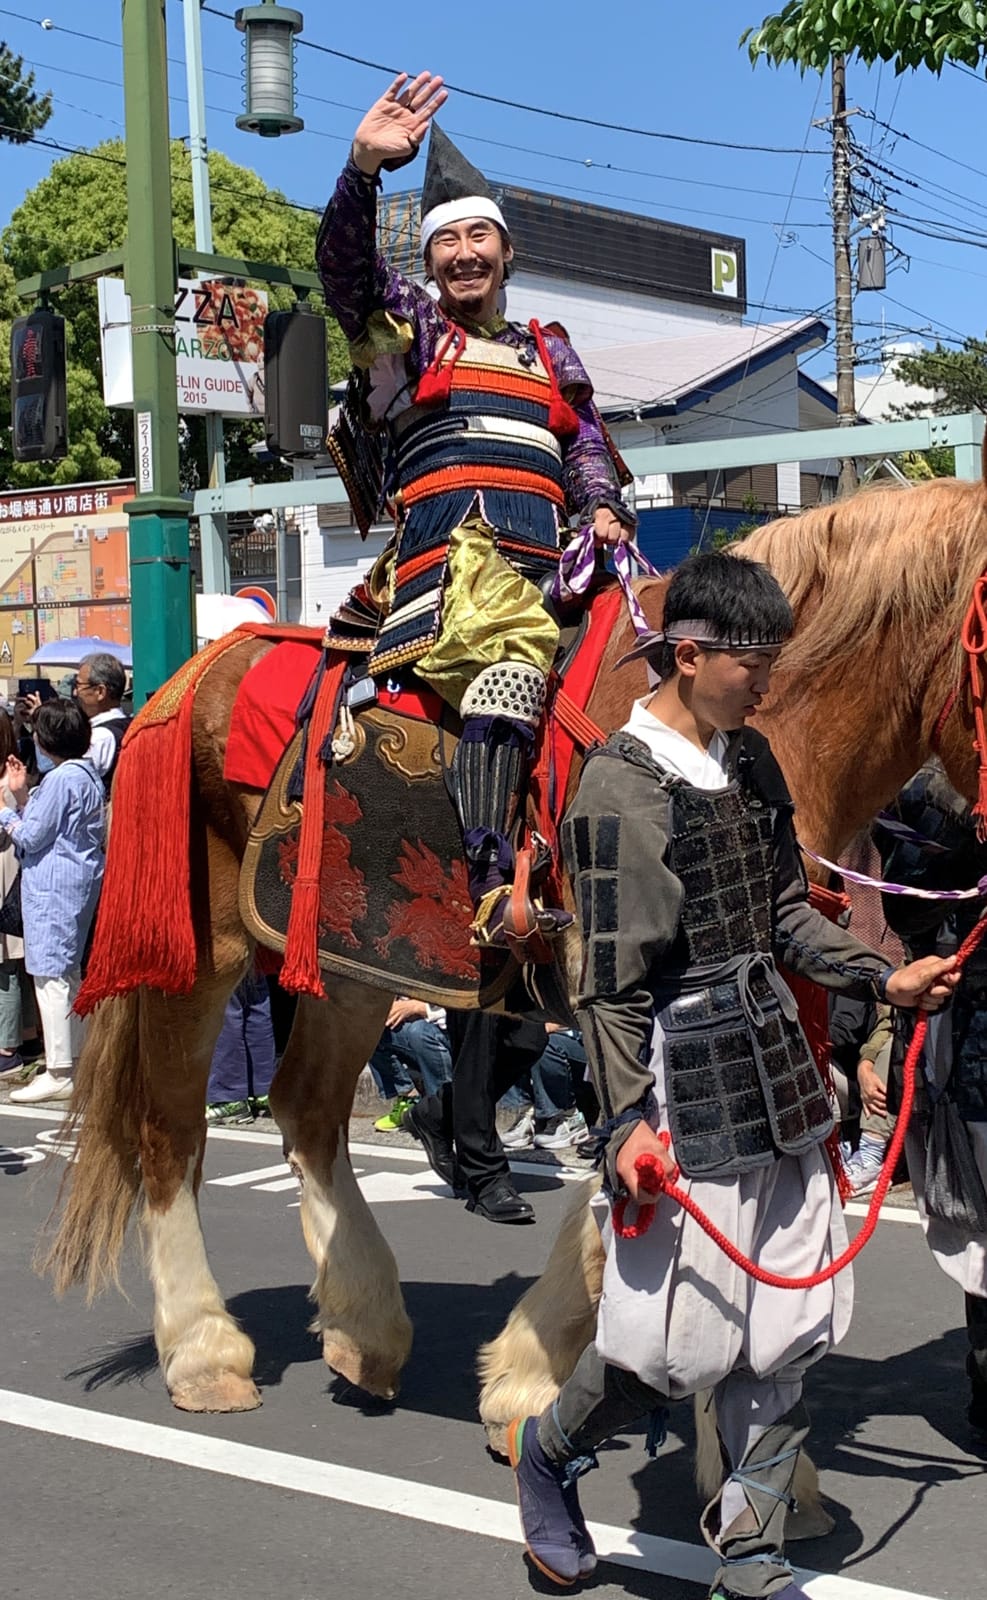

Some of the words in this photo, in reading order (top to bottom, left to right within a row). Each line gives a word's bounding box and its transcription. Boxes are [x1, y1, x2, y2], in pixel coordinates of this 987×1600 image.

[713, 253, 736, 292] P
[183, 391, 208, 404] 2015
[205, 378, 244, 393] GUIDE
[140, 423, 150, 480] 21289
